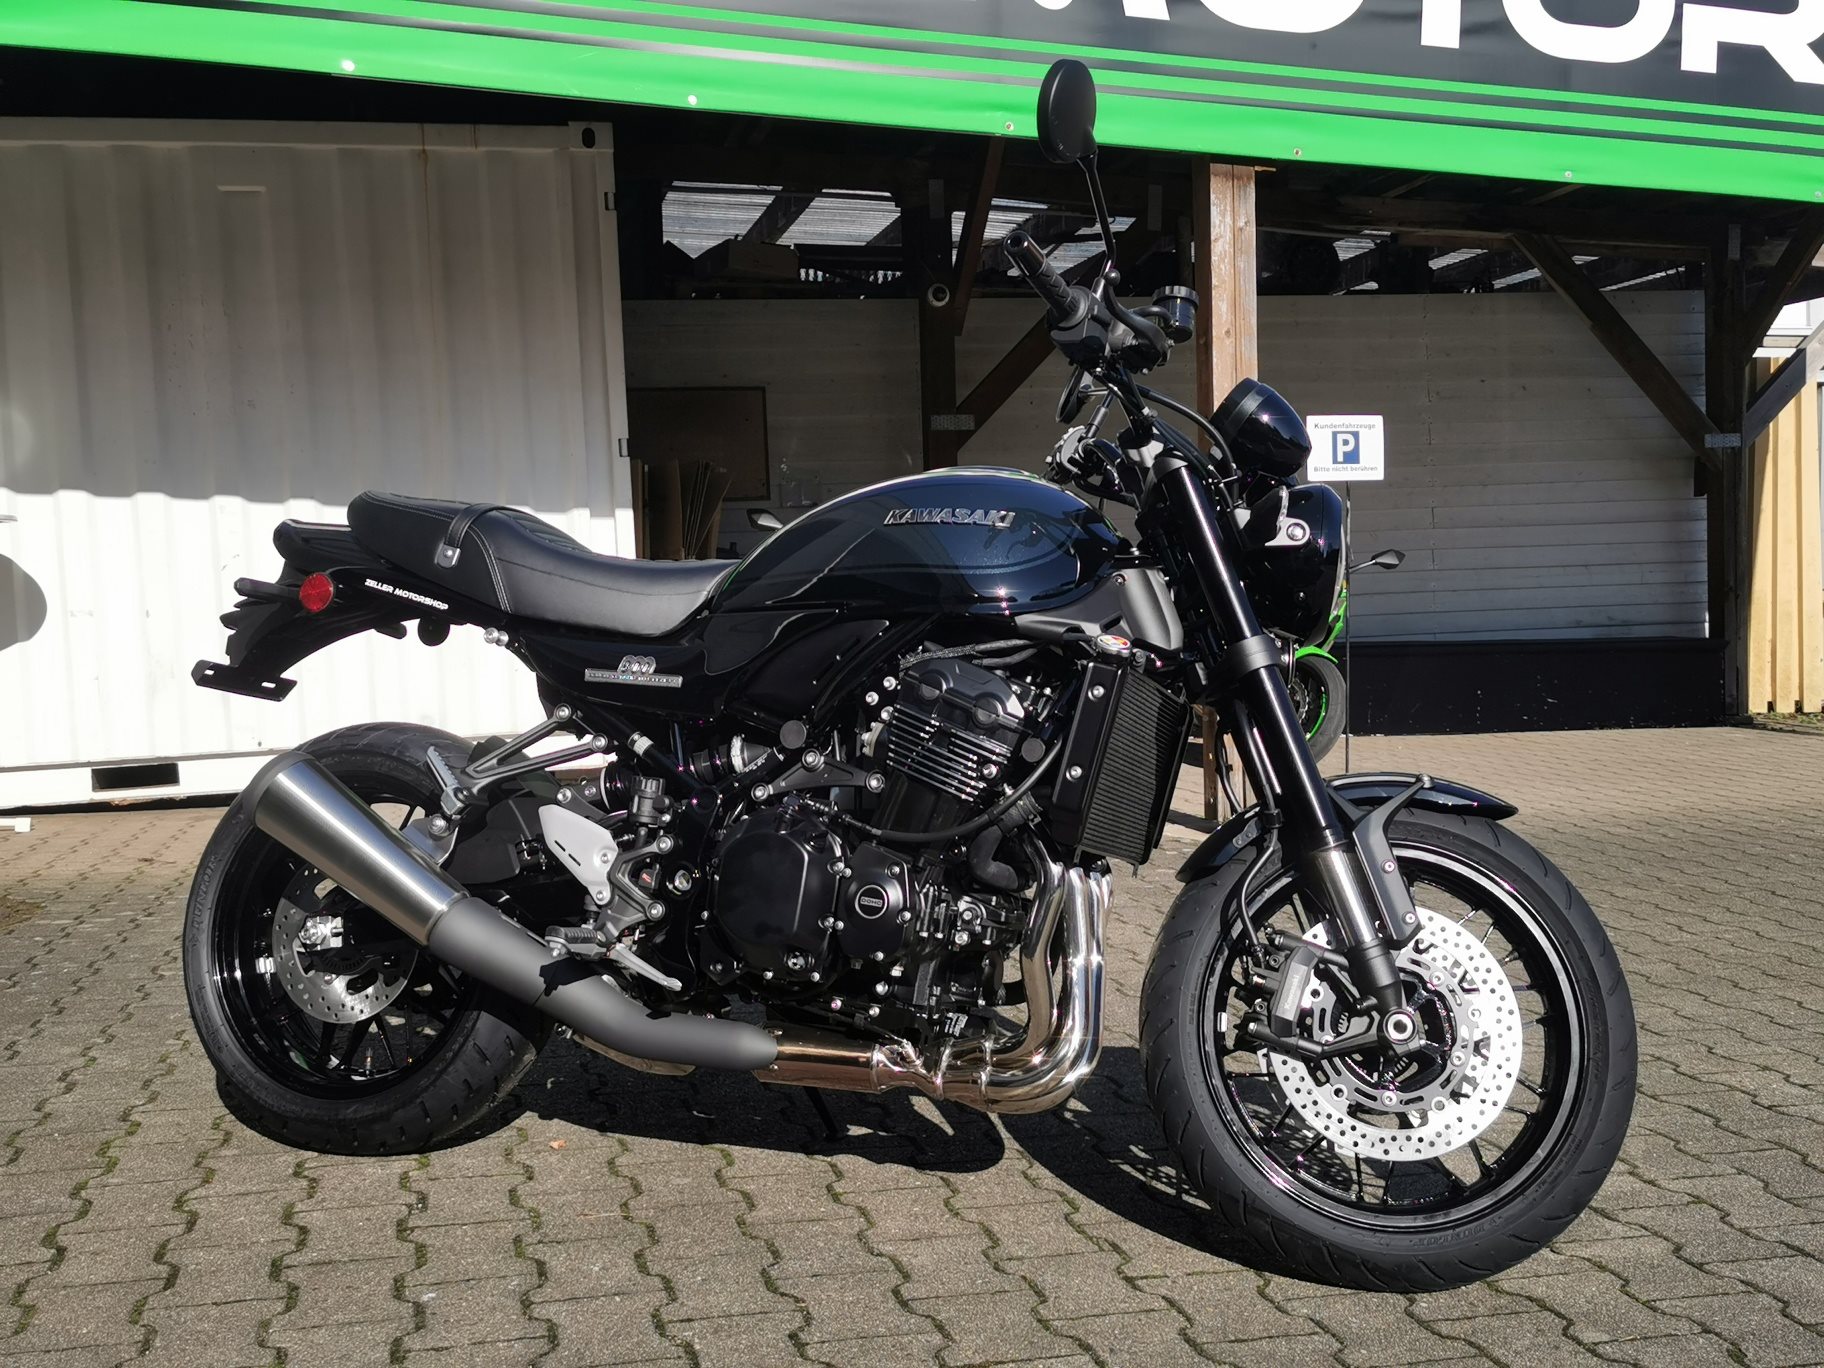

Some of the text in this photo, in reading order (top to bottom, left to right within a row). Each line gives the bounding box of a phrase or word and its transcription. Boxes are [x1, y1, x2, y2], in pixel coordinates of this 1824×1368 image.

[1314, 422, 1376, 430] Kundenfahrzeuge
[1336, 433, 1355, 462] P
[883, 508, 1016, 527] KAWASAKI
[364, 578, 449, 610] ZELLER MOTORSHOP
[861, 897, 882, 906] DOHC
